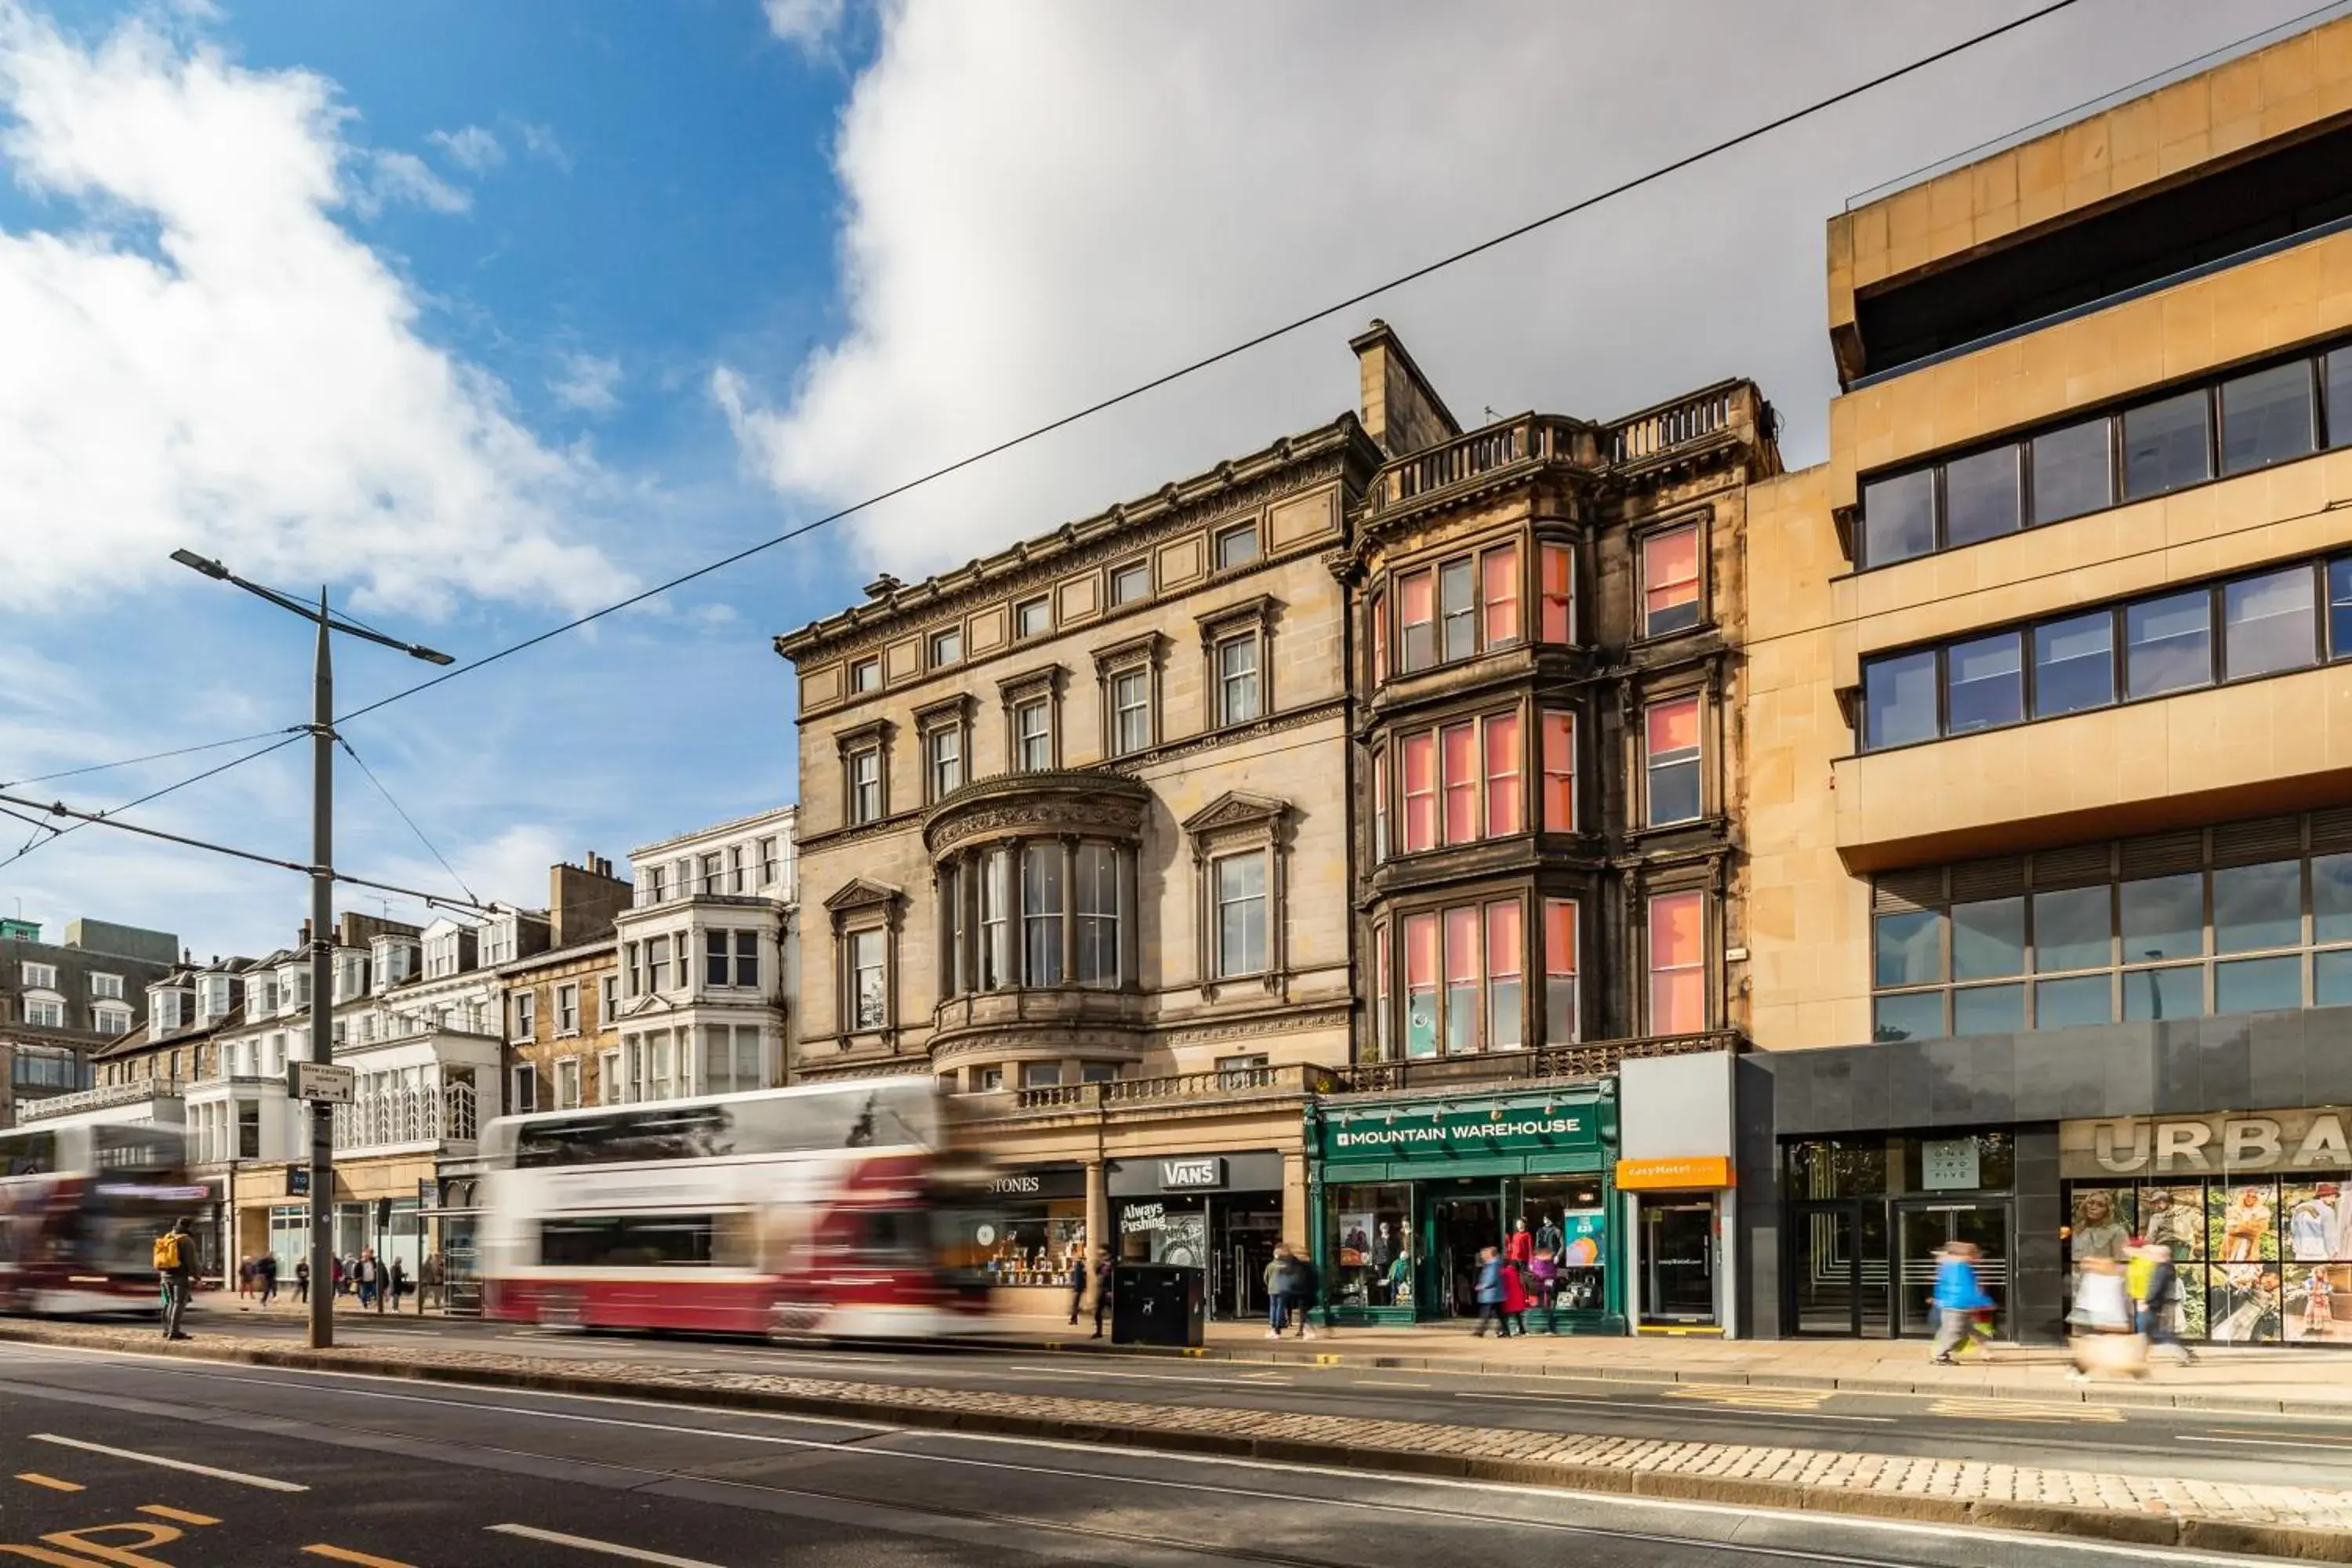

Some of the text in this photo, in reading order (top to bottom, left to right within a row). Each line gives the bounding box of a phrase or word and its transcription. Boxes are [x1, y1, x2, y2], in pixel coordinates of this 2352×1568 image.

[1350, 1118, 1581, 1145] MOUNTAIN WAREHOUSE
[2095, 1113, 2352, 1173] URBA
[1163, 1160, 1214, 1185] VANS
[1120, 1213, 1167, 1234] Pushing
[1123, 1203, 1163, 1220] Always
